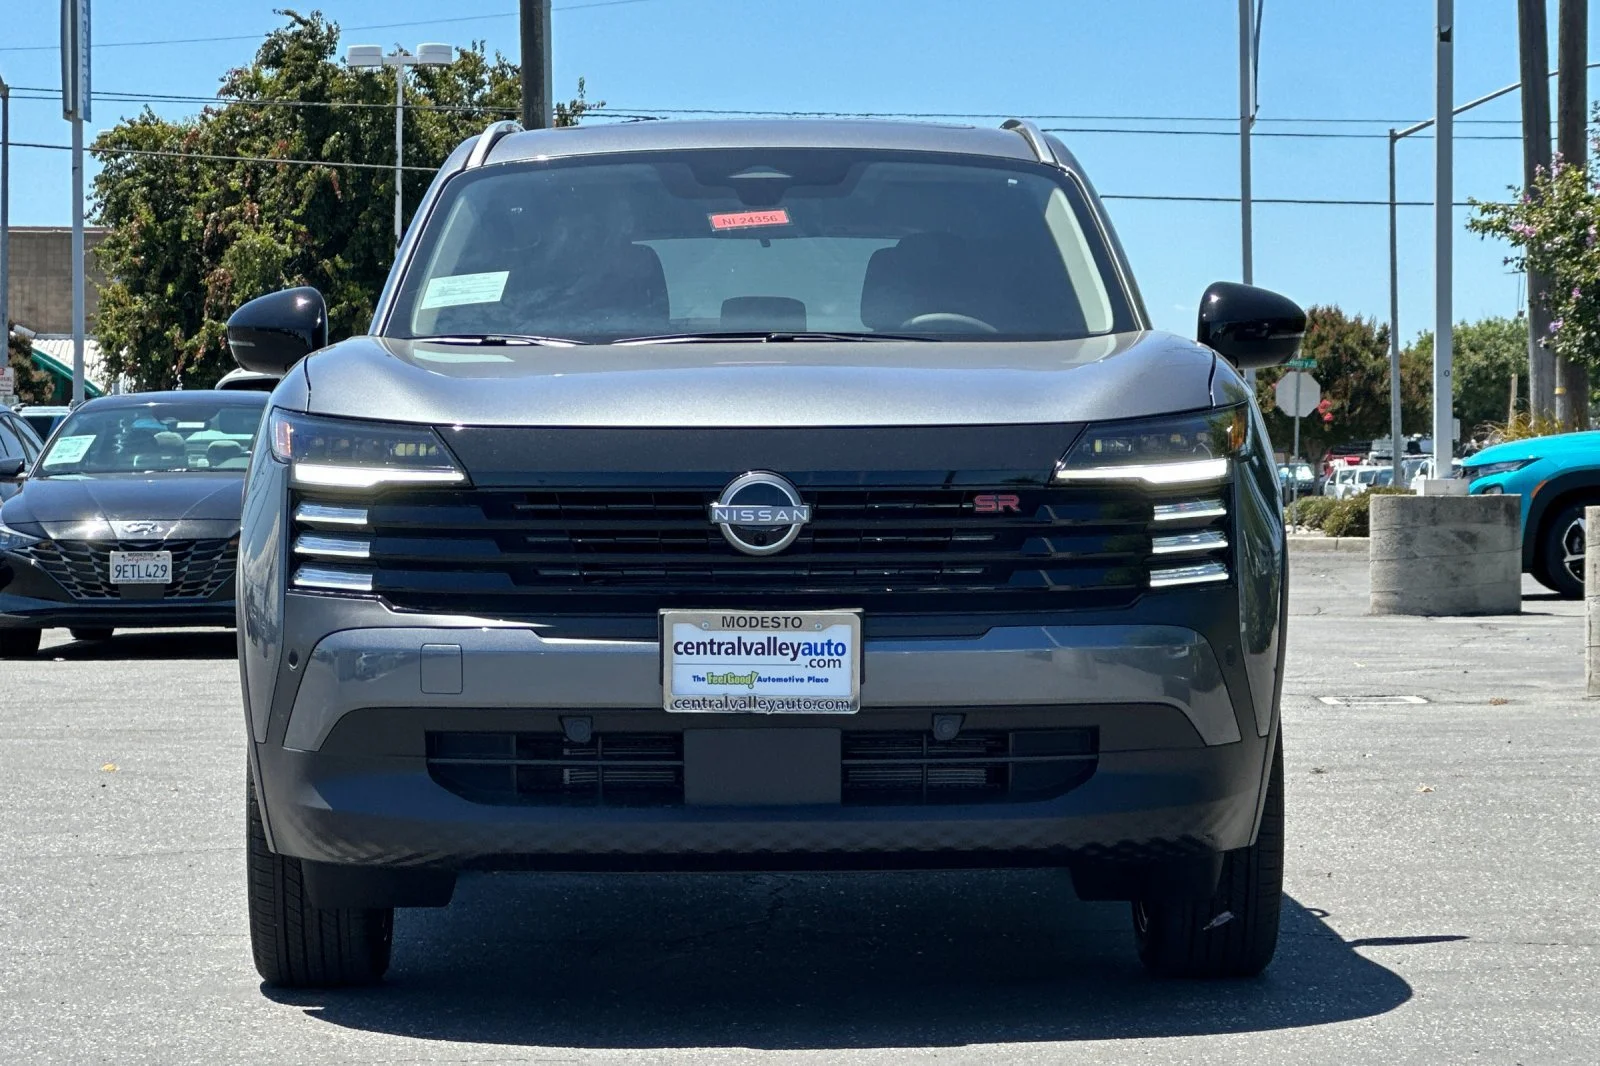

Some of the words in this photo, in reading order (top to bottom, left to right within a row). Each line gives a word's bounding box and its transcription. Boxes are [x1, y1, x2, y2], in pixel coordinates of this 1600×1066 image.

[740, 214, 778, 225] 24356
[974, 494, 1021, 513] SR
[714, 507, 807, 522] NISSAN
[115, 564, 168, 579] 9ETL429
[721, 616, 803, 628] MODESTO
[673, 636, 847, 661] centralvalleyauto
[804, 657, 842, 668] .com
[757, 674, 805, 683] Automotive
[807, 675, 829, 683] Place
[673, 695, 850, 715] centralvalleyauto.com
